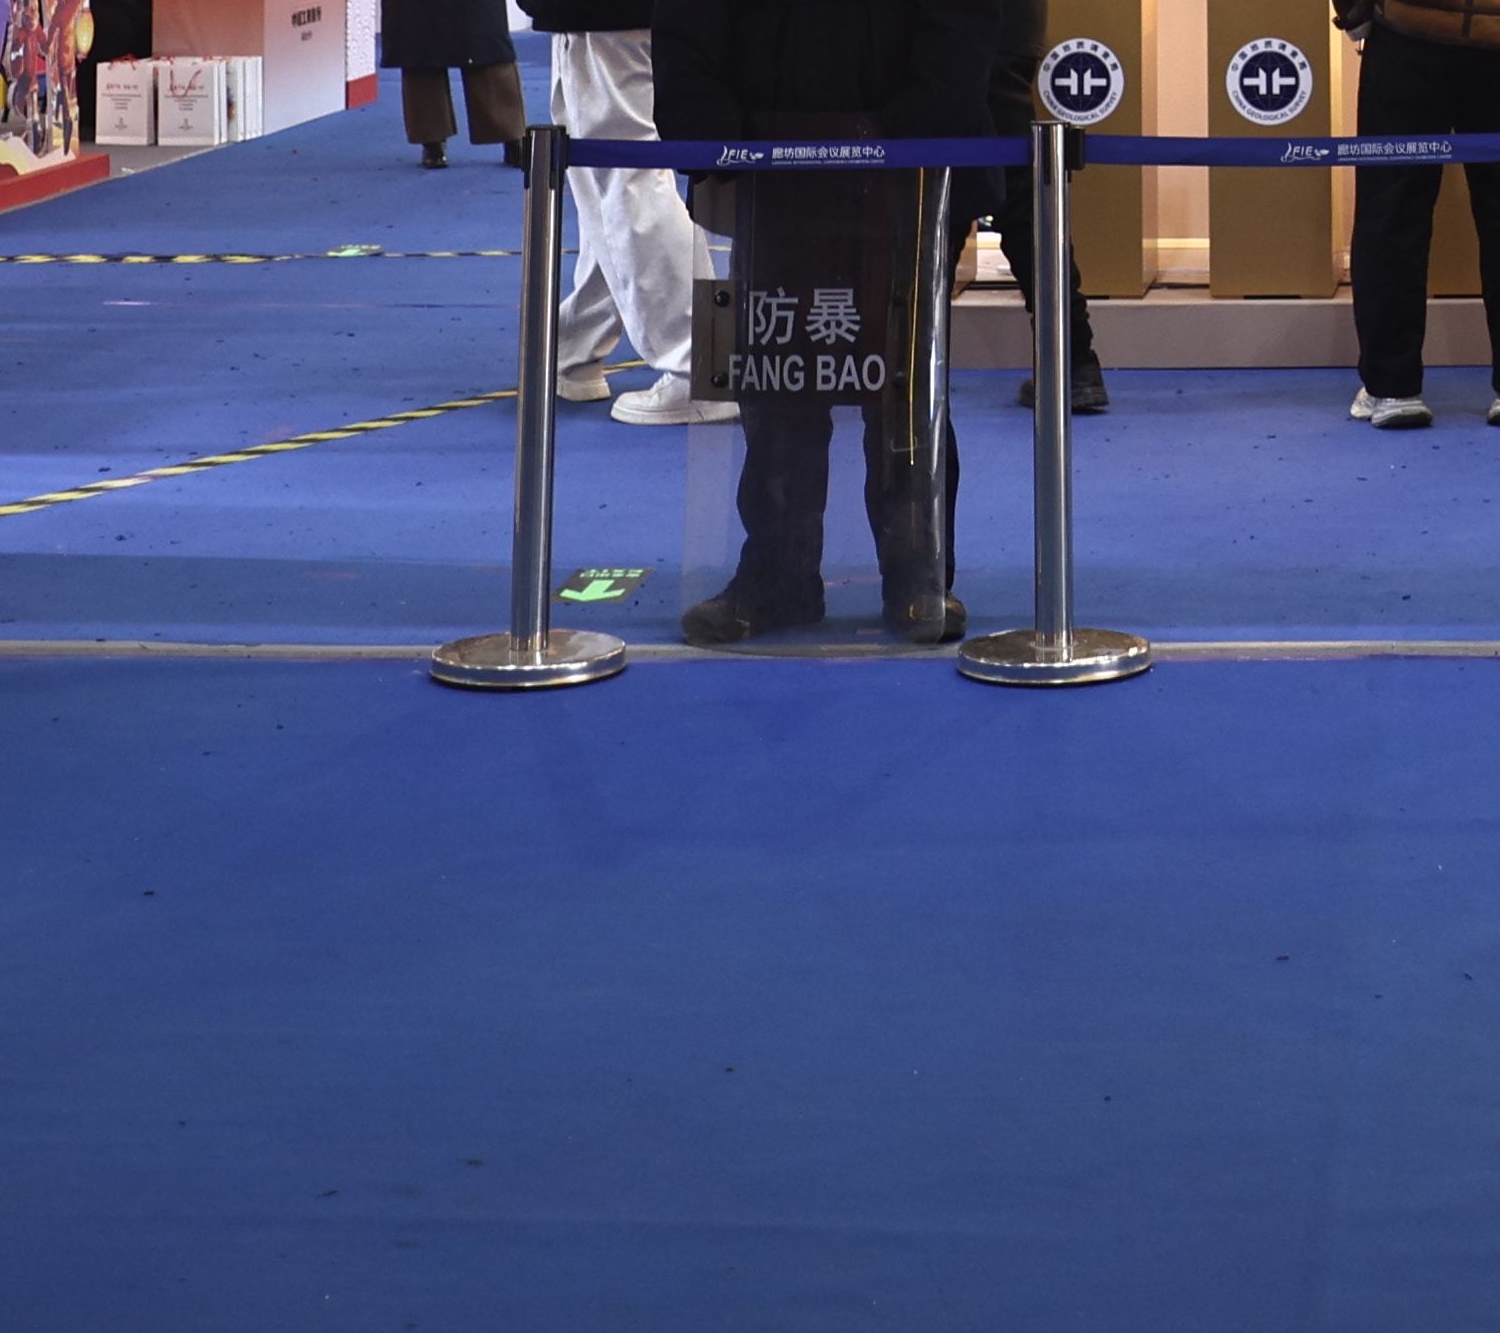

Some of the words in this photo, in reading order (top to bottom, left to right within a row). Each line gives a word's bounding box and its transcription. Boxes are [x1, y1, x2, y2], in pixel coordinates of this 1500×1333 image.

[771, 144, 886, 160] 廊坊国际会议展览中心
[1337, 140, 1453, 157] 廊坊国际会议展览中心
[748, 286, 862, 346] 防暴
[728, 354, 806, 391] FANG
[816, 354, 886, 392] BAO
